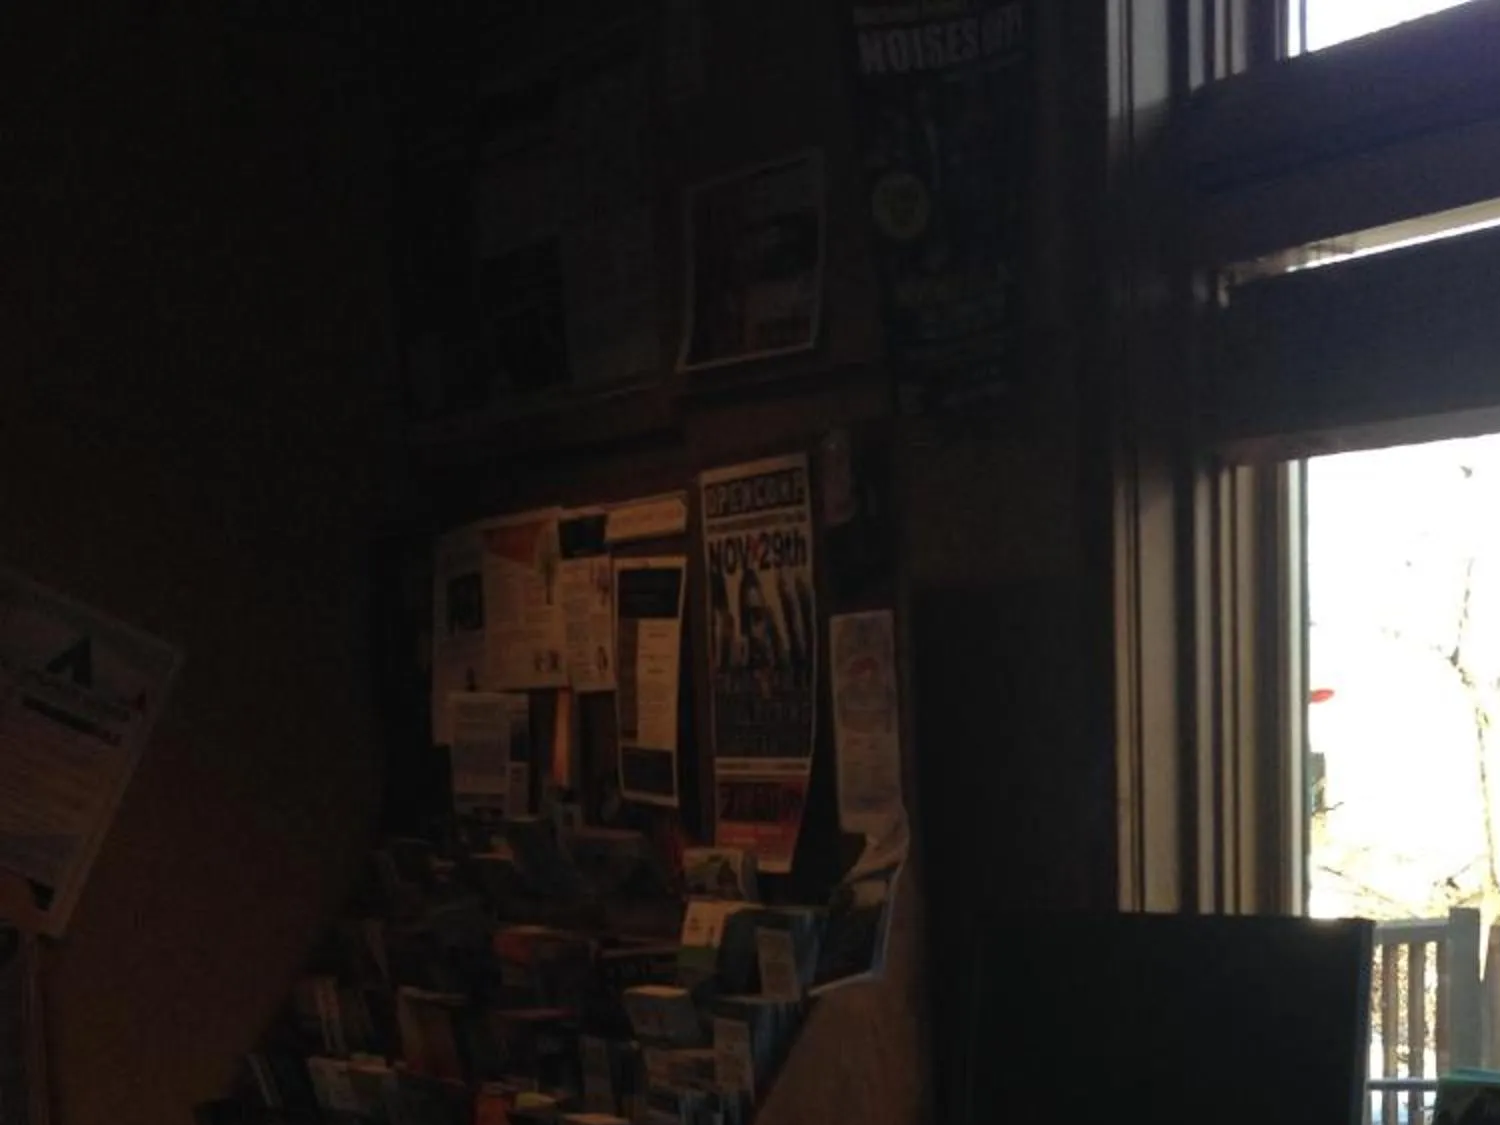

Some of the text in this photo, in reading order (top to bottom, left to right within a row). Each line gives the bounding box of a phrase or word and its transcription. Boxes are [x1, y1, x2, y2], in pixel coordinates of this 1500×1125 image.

[858, 17, 980, 75] NOISES
[708, 529, 807, 576] NOV 29th
